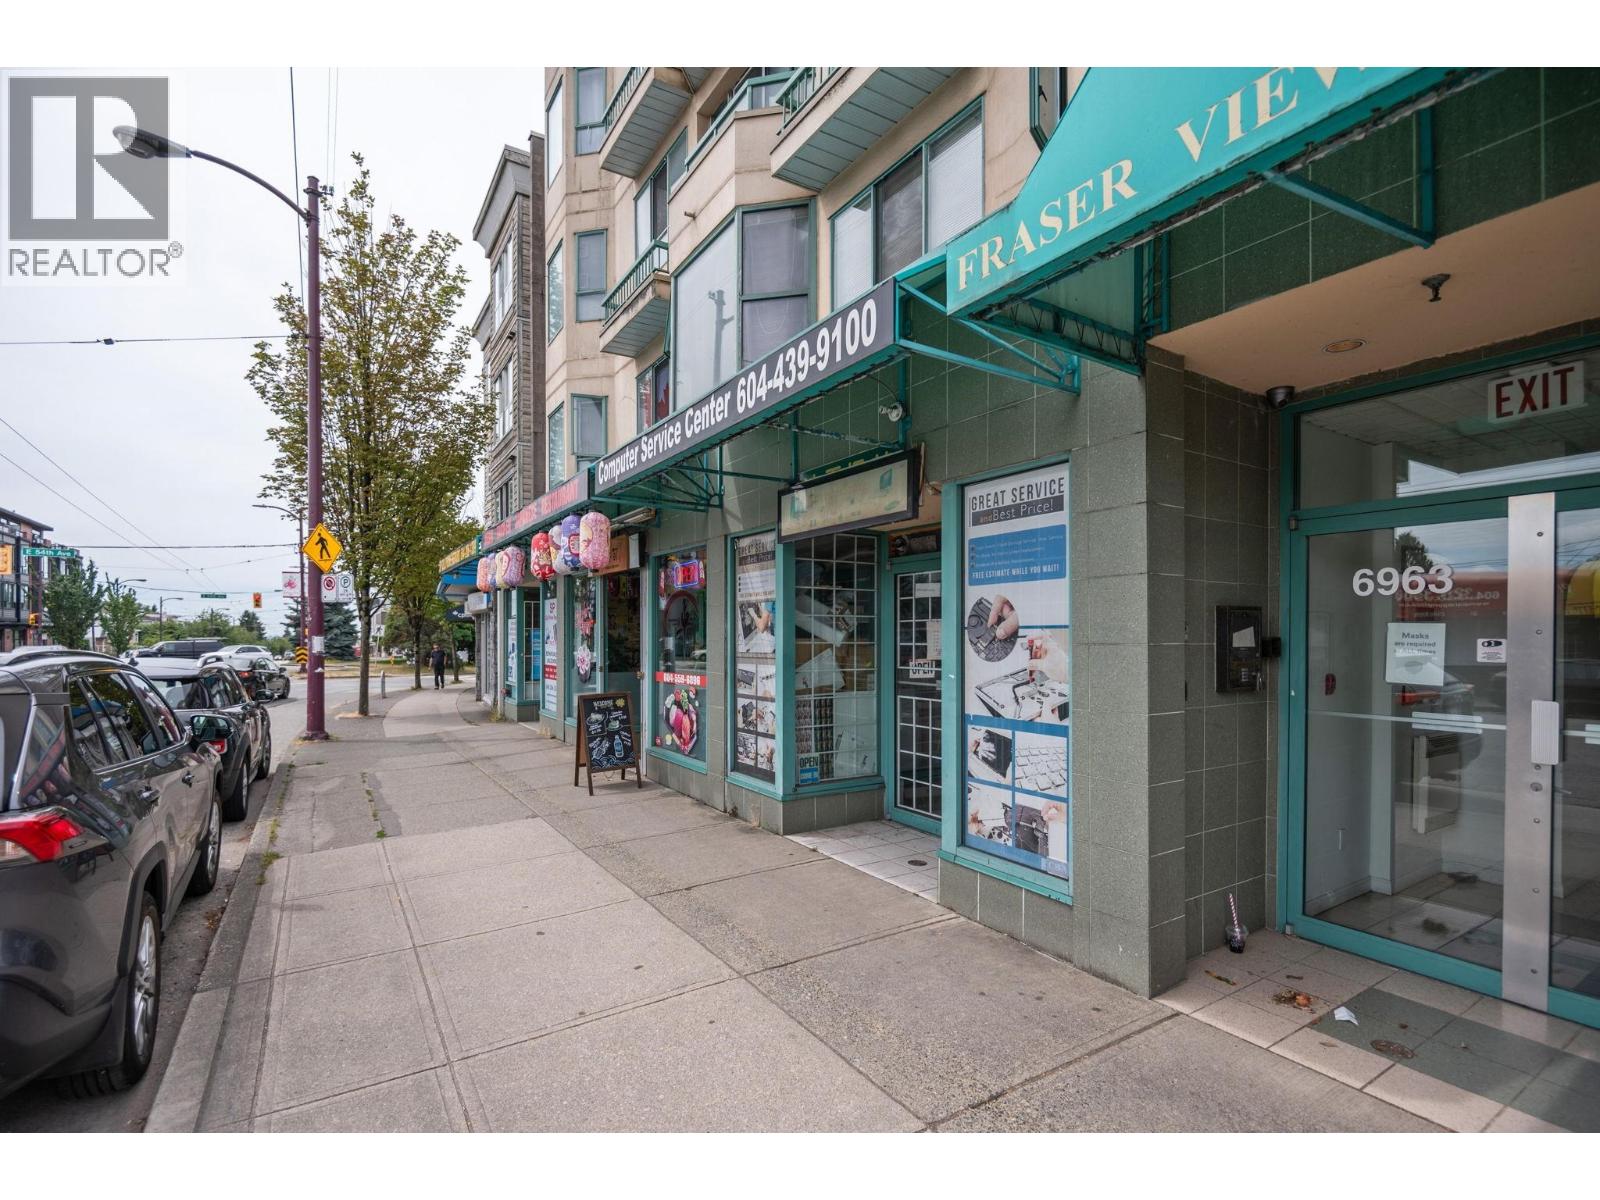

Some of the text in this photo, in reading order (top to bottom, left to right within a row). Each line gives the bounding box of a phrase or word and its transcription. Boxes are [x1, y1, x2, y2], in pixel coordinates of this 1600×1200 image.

[958, 159, 1138, 291] FRASER
[598, 298, 877, 486] Computer Service Center 604-439-9100
[1495, 366, 1575, 418] EXIT
[971, 489, 1006, 512] GREAT
[1011, 477, 1065, 503] SERVICE
[992, 507, 1015, 521] Best
[1020, 498, 1054, 516] Price!
[1352, 564, 1454, 597] 6963
[1401, 632, 1430, 640] Masks
[911, 660, 934, 675] OPEN
[799, 756, 819, 768] OPEN
